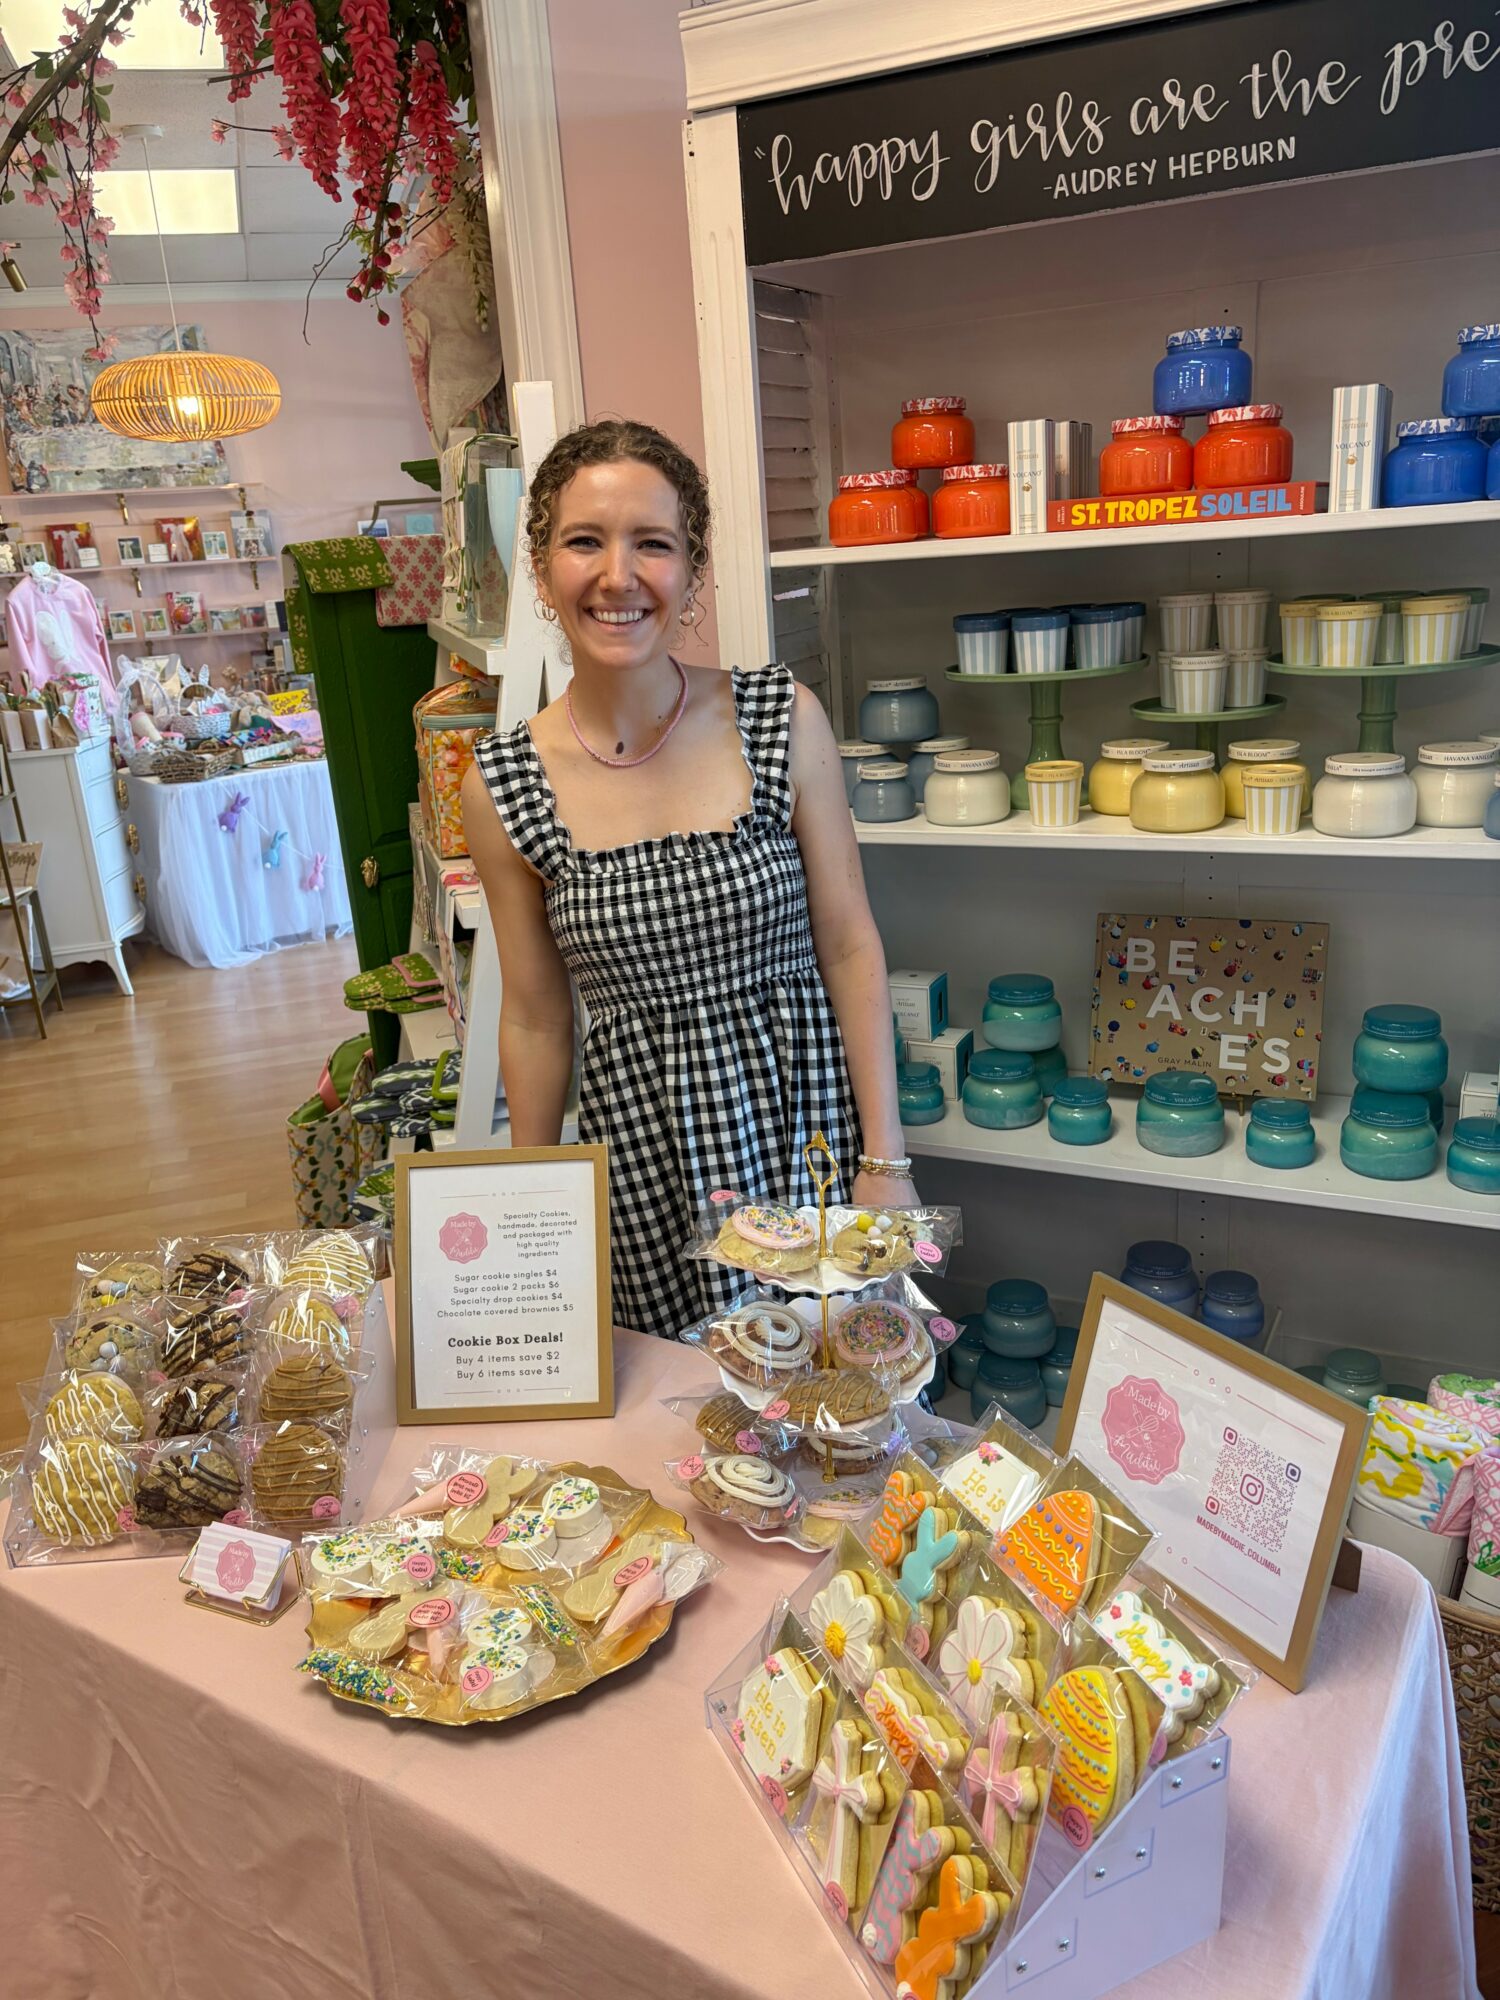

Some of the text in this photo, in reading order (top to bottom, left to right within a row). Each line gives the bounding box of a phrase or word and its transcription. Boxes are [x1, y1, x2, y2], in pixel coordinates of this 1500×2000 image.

[970, 91, 1112, 193] girls
[1130, 79, 1230, 135] are
[1239, 49, 1362, 117] the
[1379, 10, 1500, 115] pre
[1043, 135, 1297, 200] -AUDREY HEPBURN
[1071, 502, 1101, 527] ST.
[1105, 495, 1198, 524] TROPEZ
[1200, 488, 1292, 518] SOLEIL
[1126, 937, 1198, 976] BE
[1146, 984, 1268, 1027] ACH
[1157, 1056, 1212, 1068] GRAY MALIN
[1218, 1034, 1292, 1075] ES
[503, 1210, 571, 1221] Specialty Cookies,
[497, 1219, 577, 1230] handmade, decorated
[519, 1230, 555, 1240] packaged
[516, 1240, 560, 1249] high quality
[518, 1249, 559, 1259] ingredients
[454, 1269, 557, 1283] Sugar cookie singles $4
[453, 1280, 560, 1295] Sugar cookie 2 packs $6
[450, 1292, 563, 1307] Specialty drop cookies $4
[437, 1303, 574, 1318] Chocolate covered brownies $5
[447, 1331, 564, 1348] Cookie Box Deals!
[456, 1351, 560, 1366] Buy 4 items save $2
[457, 1365, 560, 1381] Buy 6 items save $4
[1127, 1385, 1171, 1421] Made by
[961, 1466, 1006, 1513] He is
[1196, 1514, 1281, 1577] MADEBYMADDIE_COLUMBIA
[754, 1681, 787, 1738] He is
[744, 1705, 777, 1762] risen
